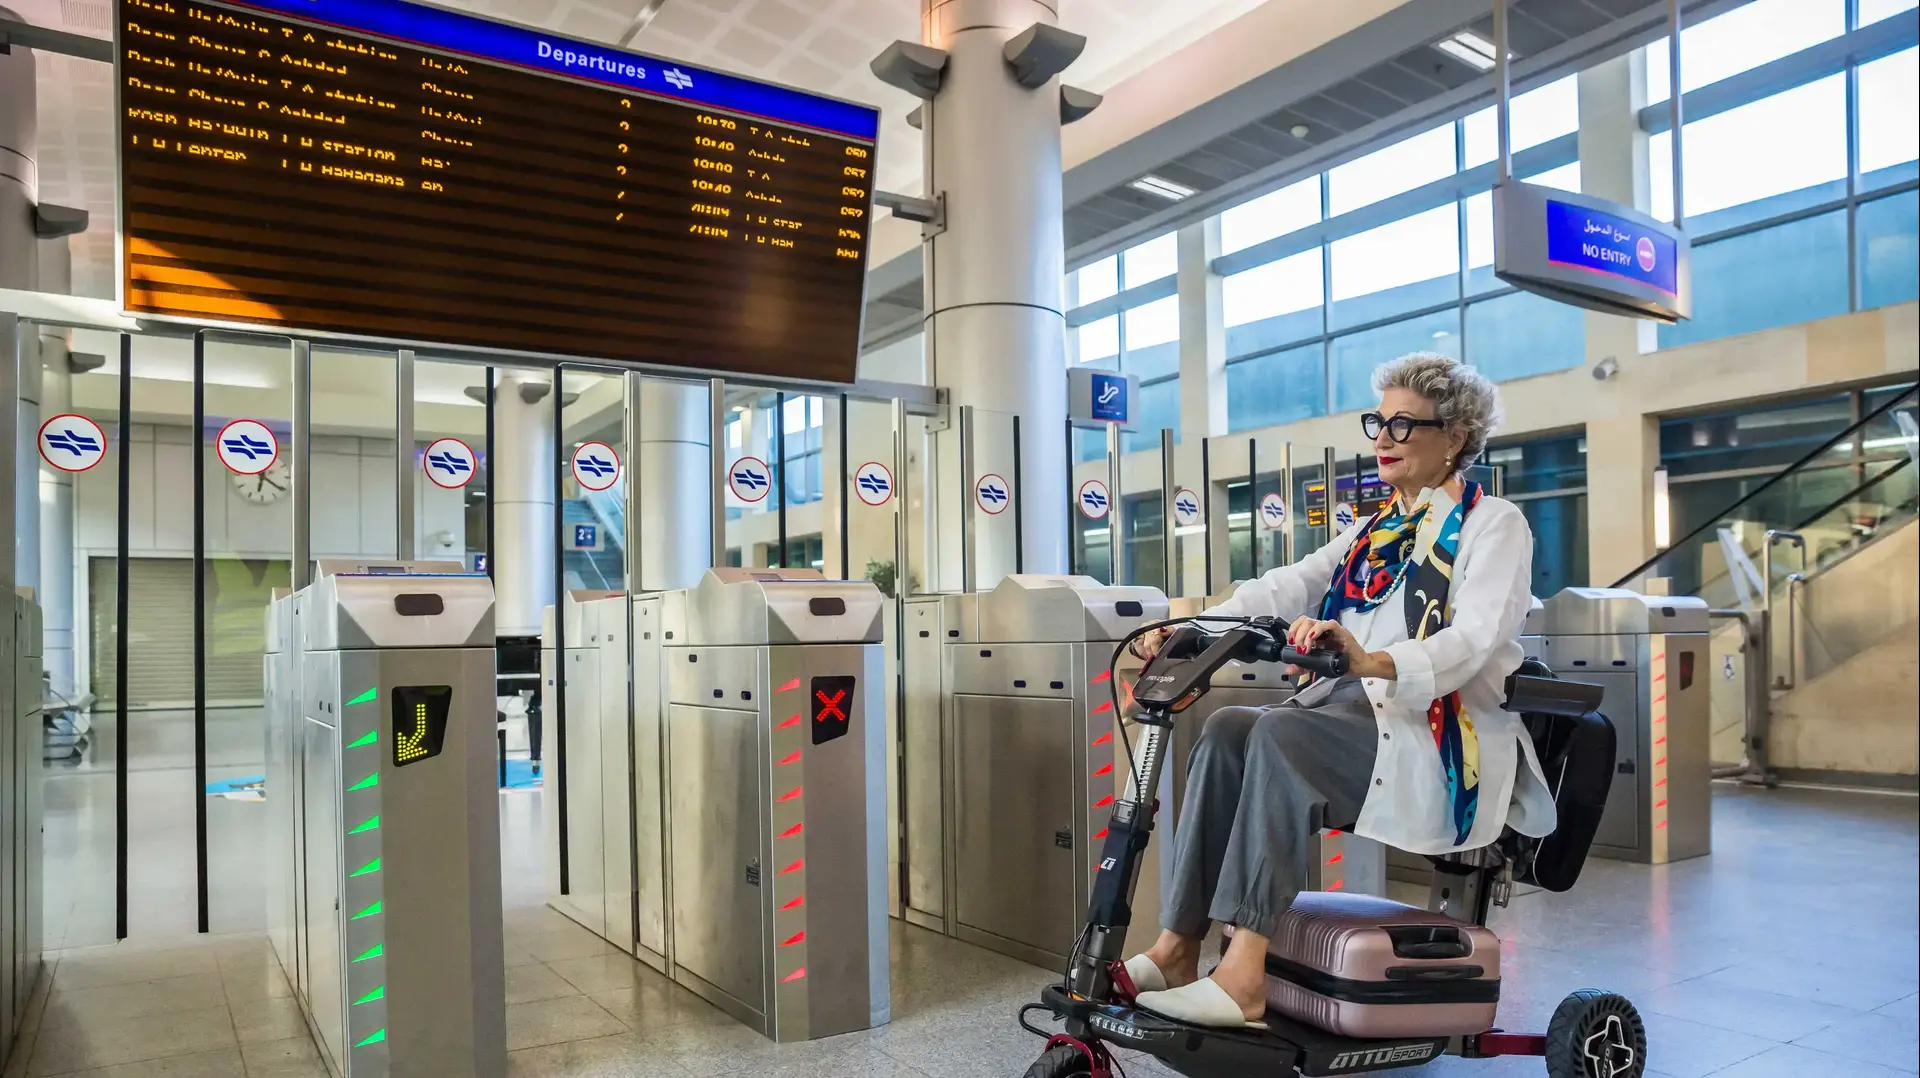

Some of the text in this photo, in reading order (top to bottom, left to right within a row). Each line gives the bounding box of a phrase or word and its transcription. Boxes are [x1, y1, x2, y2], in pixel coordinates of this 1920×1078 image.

[537, 41, 647, 79] Departures
[1582, 242, 1632, 267] NO ENTRY
[578, 528, 585, 540] 2
[1392, 1046, 1434, 1061] SPORT
